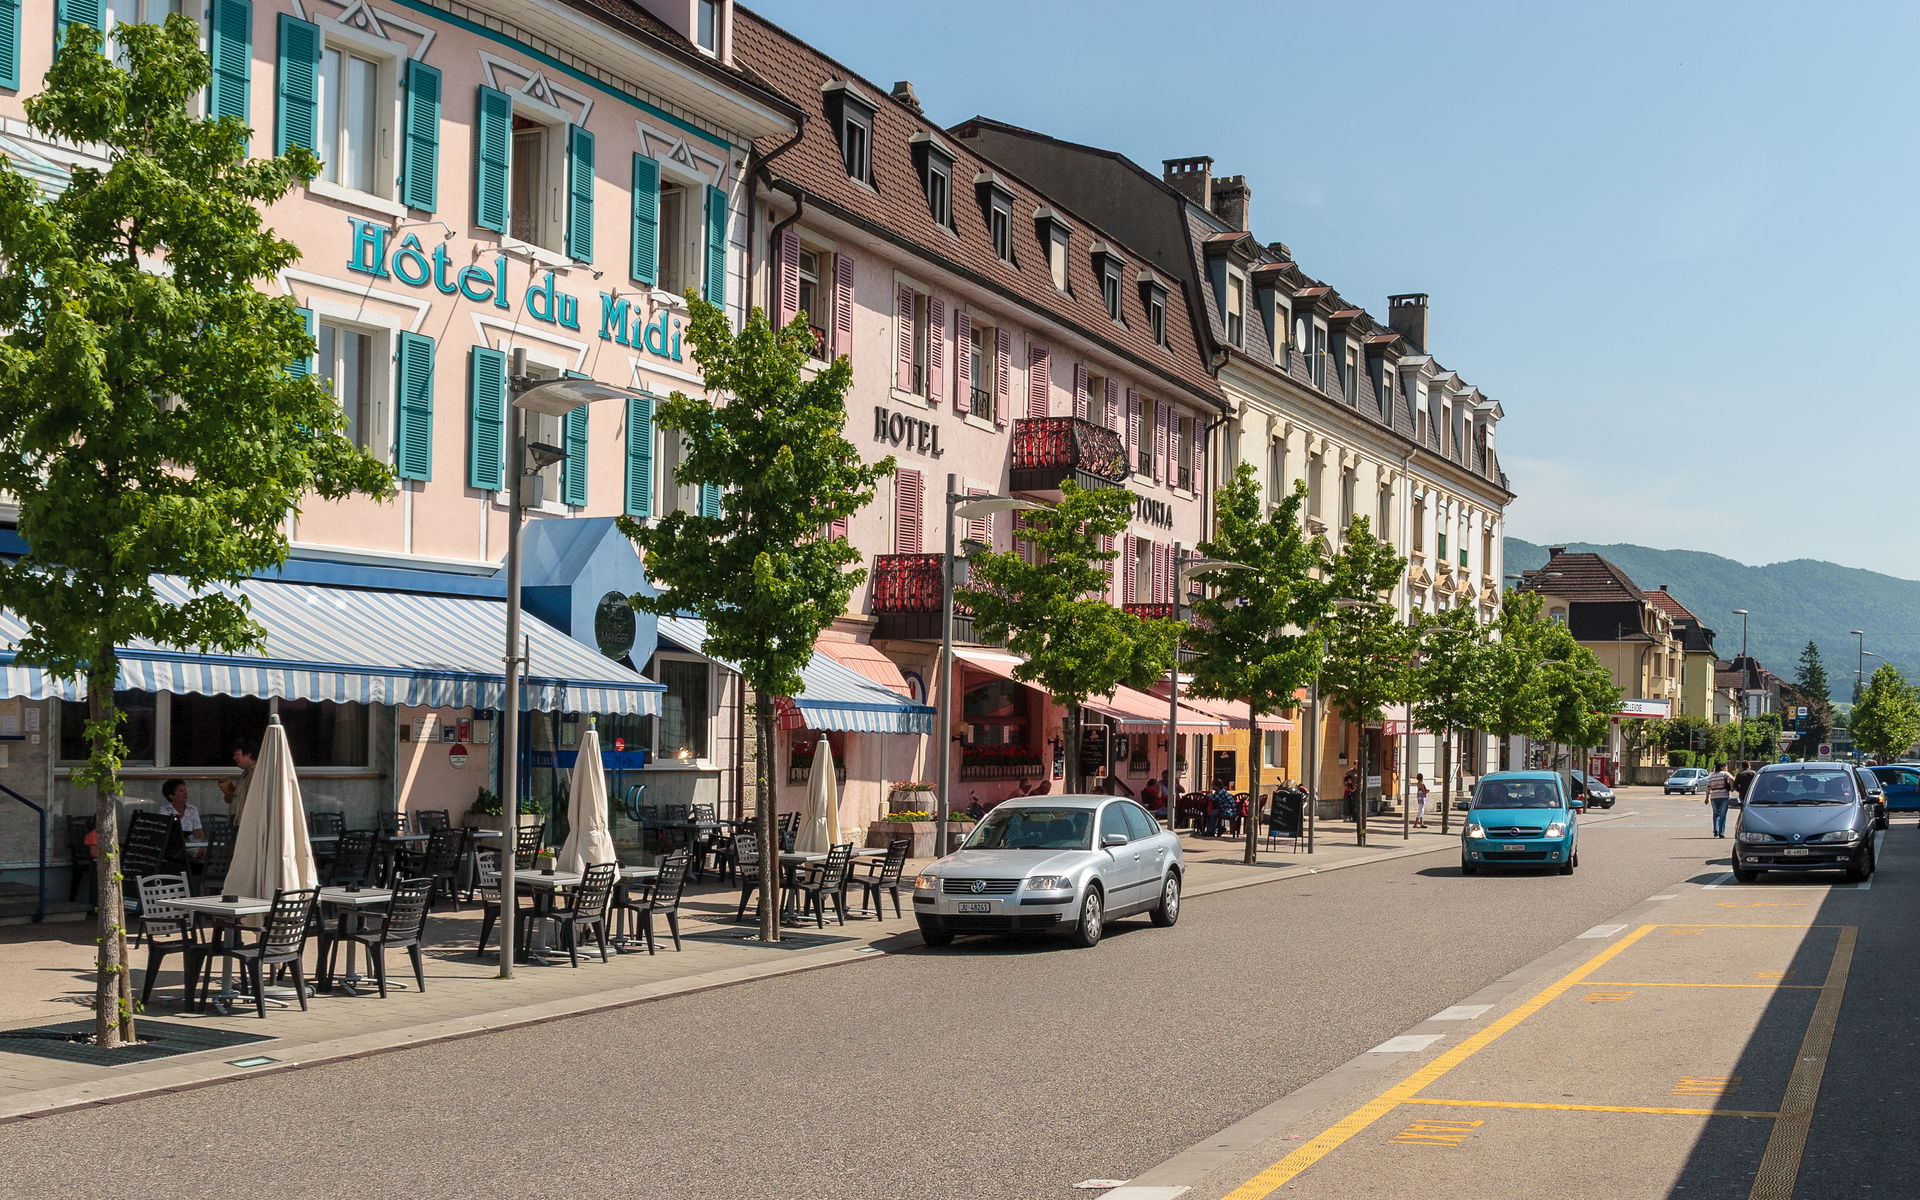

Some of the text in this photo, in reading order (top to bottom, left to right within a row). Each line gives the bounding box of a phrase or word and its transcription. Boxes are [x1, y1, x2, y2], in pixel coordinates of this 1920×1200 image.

[347, 215, 683, 362] Hôtel du Midi
[874, 405, 945, 457] HOTEL
